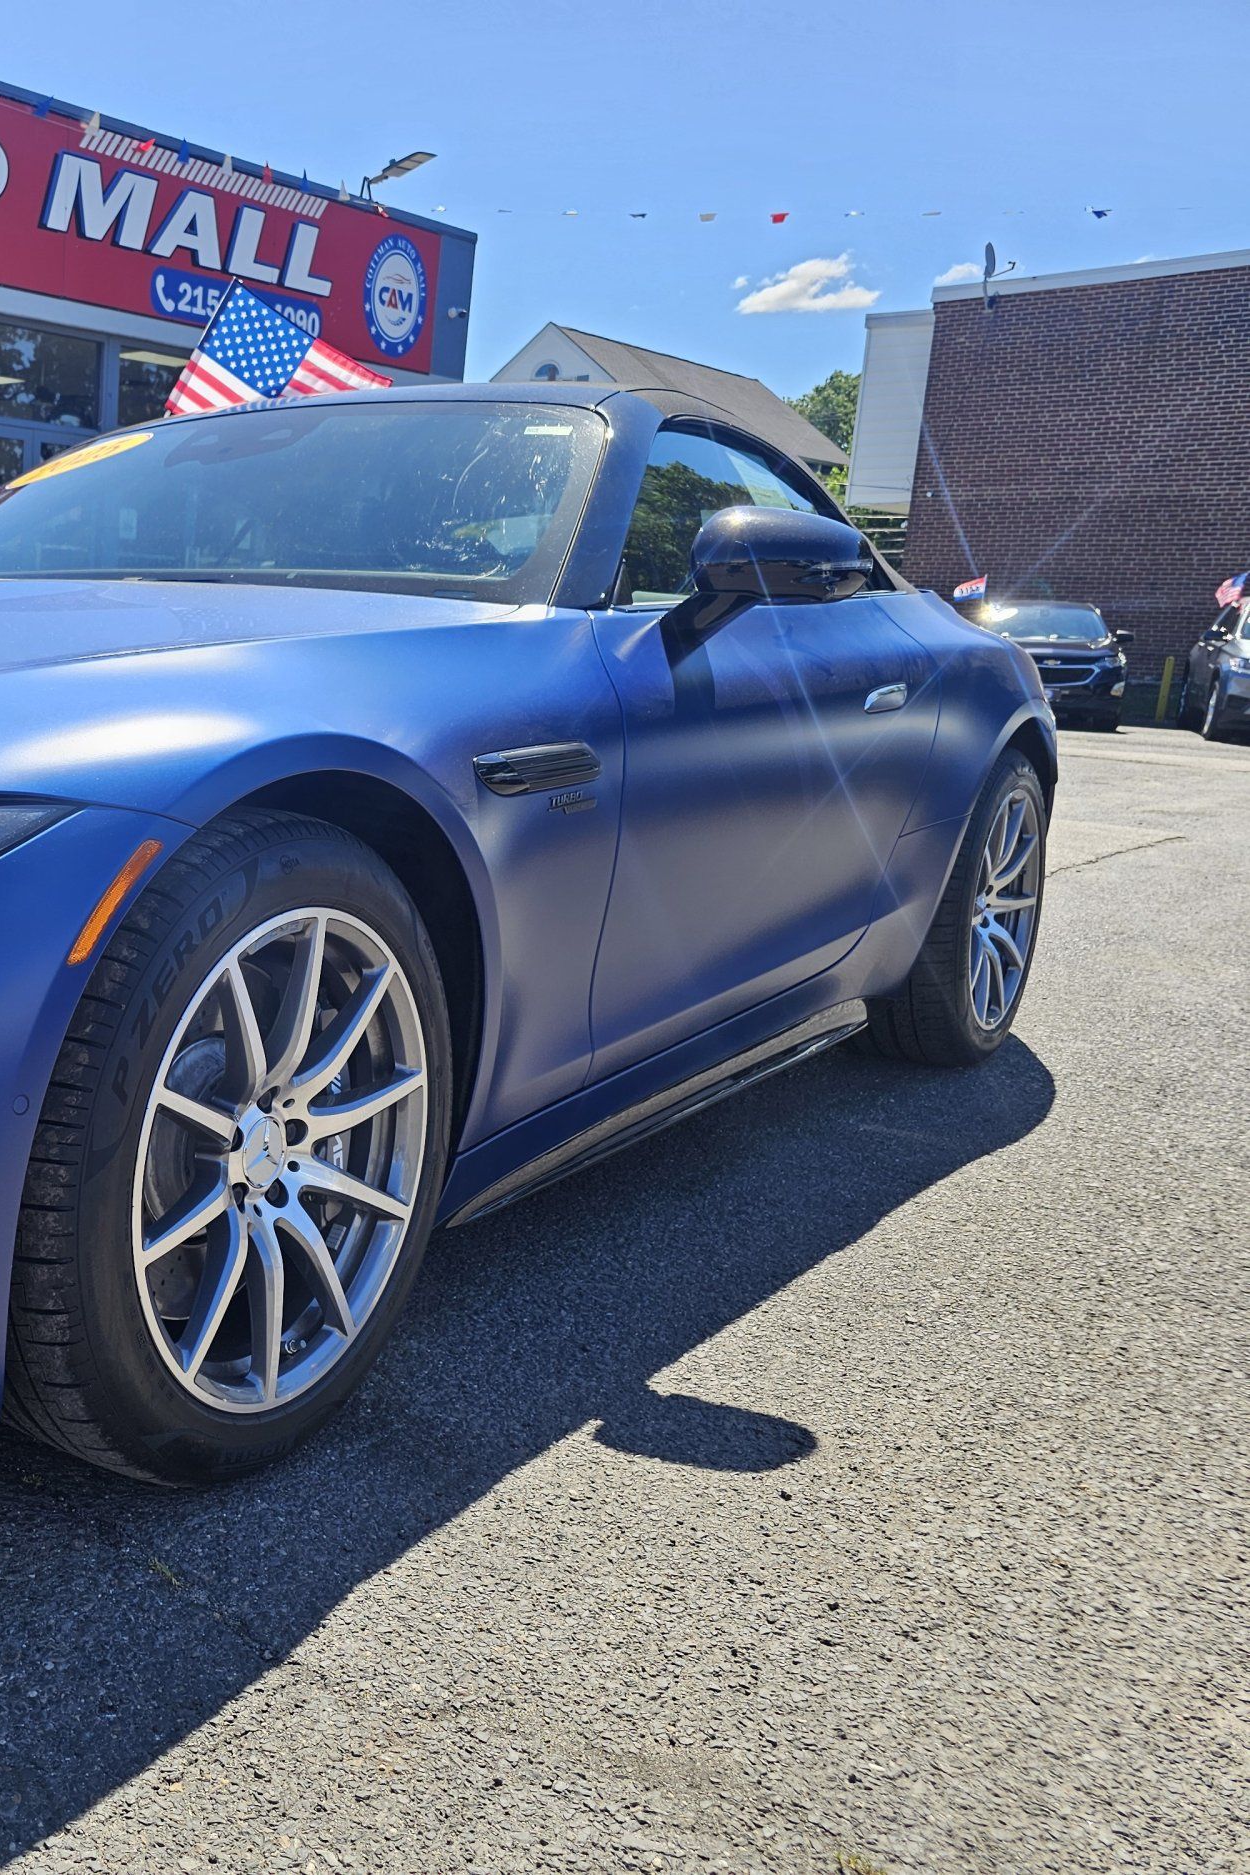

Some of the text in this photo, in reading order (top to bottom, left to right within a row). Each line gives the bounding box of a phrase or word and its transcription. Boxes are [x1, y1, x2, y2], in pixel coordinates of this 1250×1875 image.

[41, 150, 333, 297] MALL
[378, 286, 414, 314] CAM
[550, 790, 583, 808] TURBO
[130, 897, 224, 1050] ZERO
